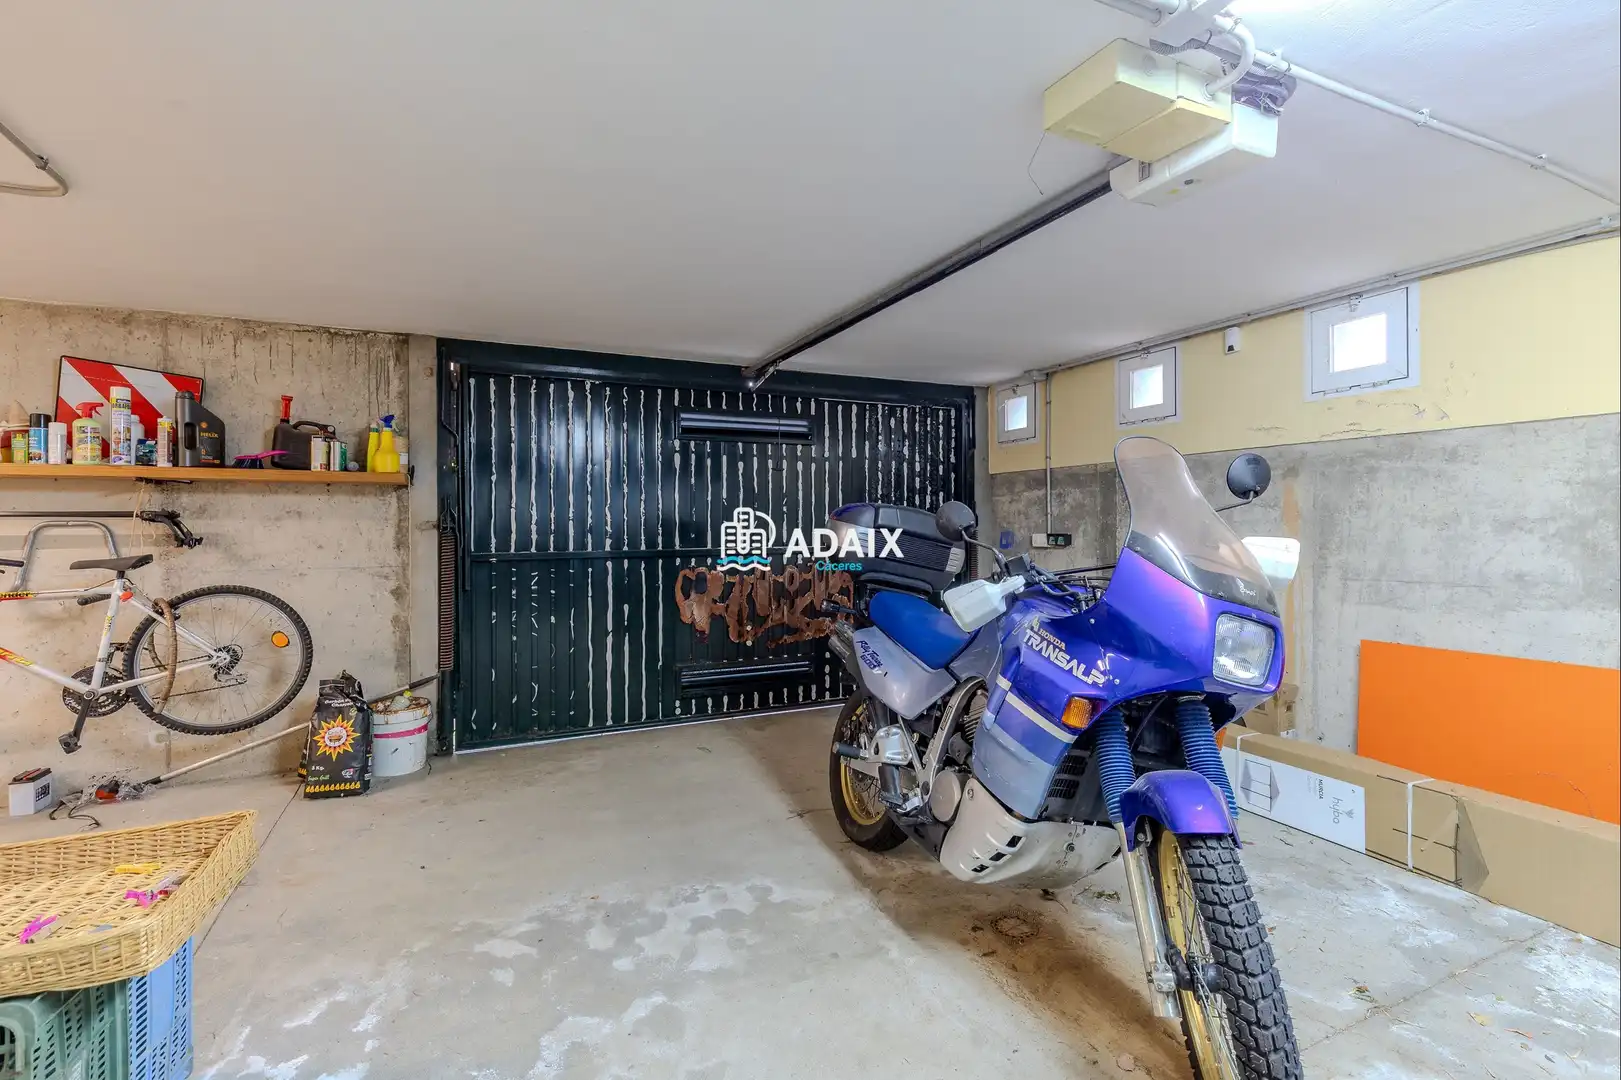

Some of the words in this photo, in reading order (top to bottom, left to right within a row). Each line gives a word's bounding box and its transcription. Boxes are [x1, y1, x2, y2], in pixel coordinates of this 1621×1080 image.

[1039, 628, 1066, 651] HONDA
[1023, 628, 1106, 687] TRANSALP
[1329, 796, 1344, 824] hybo
